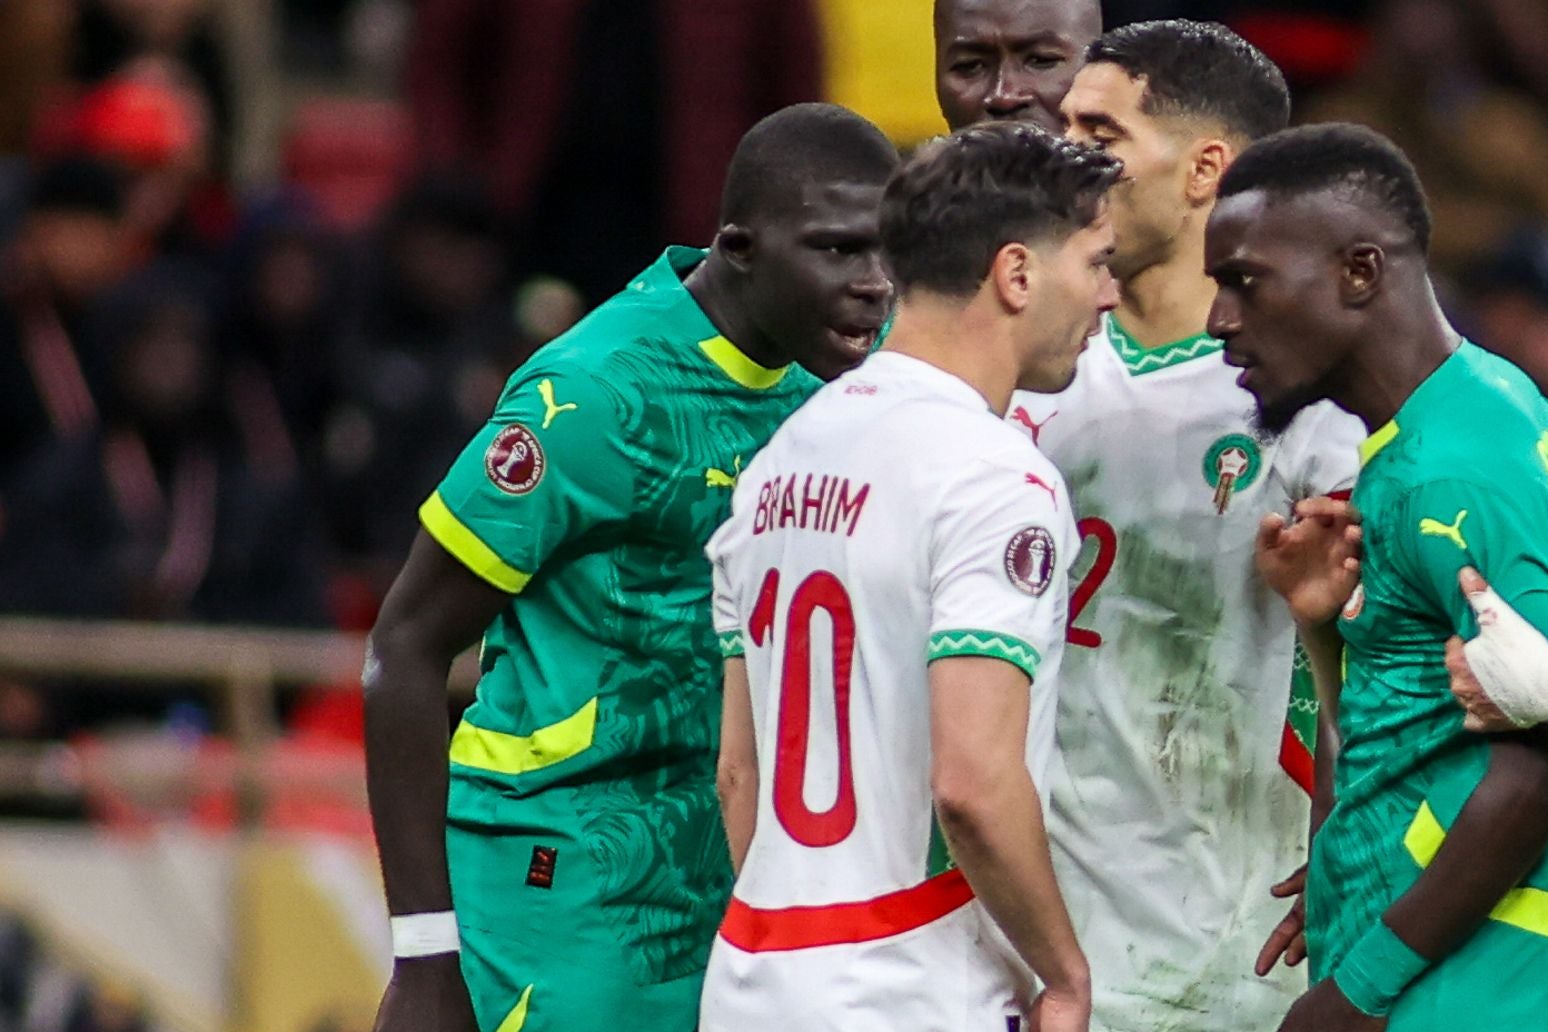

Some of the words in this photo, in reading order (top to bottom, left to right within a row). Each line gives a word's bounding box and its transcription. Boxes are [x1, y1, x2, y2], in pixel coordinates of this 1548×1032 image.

[752, 472, 871, 536] BRAHIM
[1066, 516, 1117, 648] 2
[748, 566, 857, 848] 10
